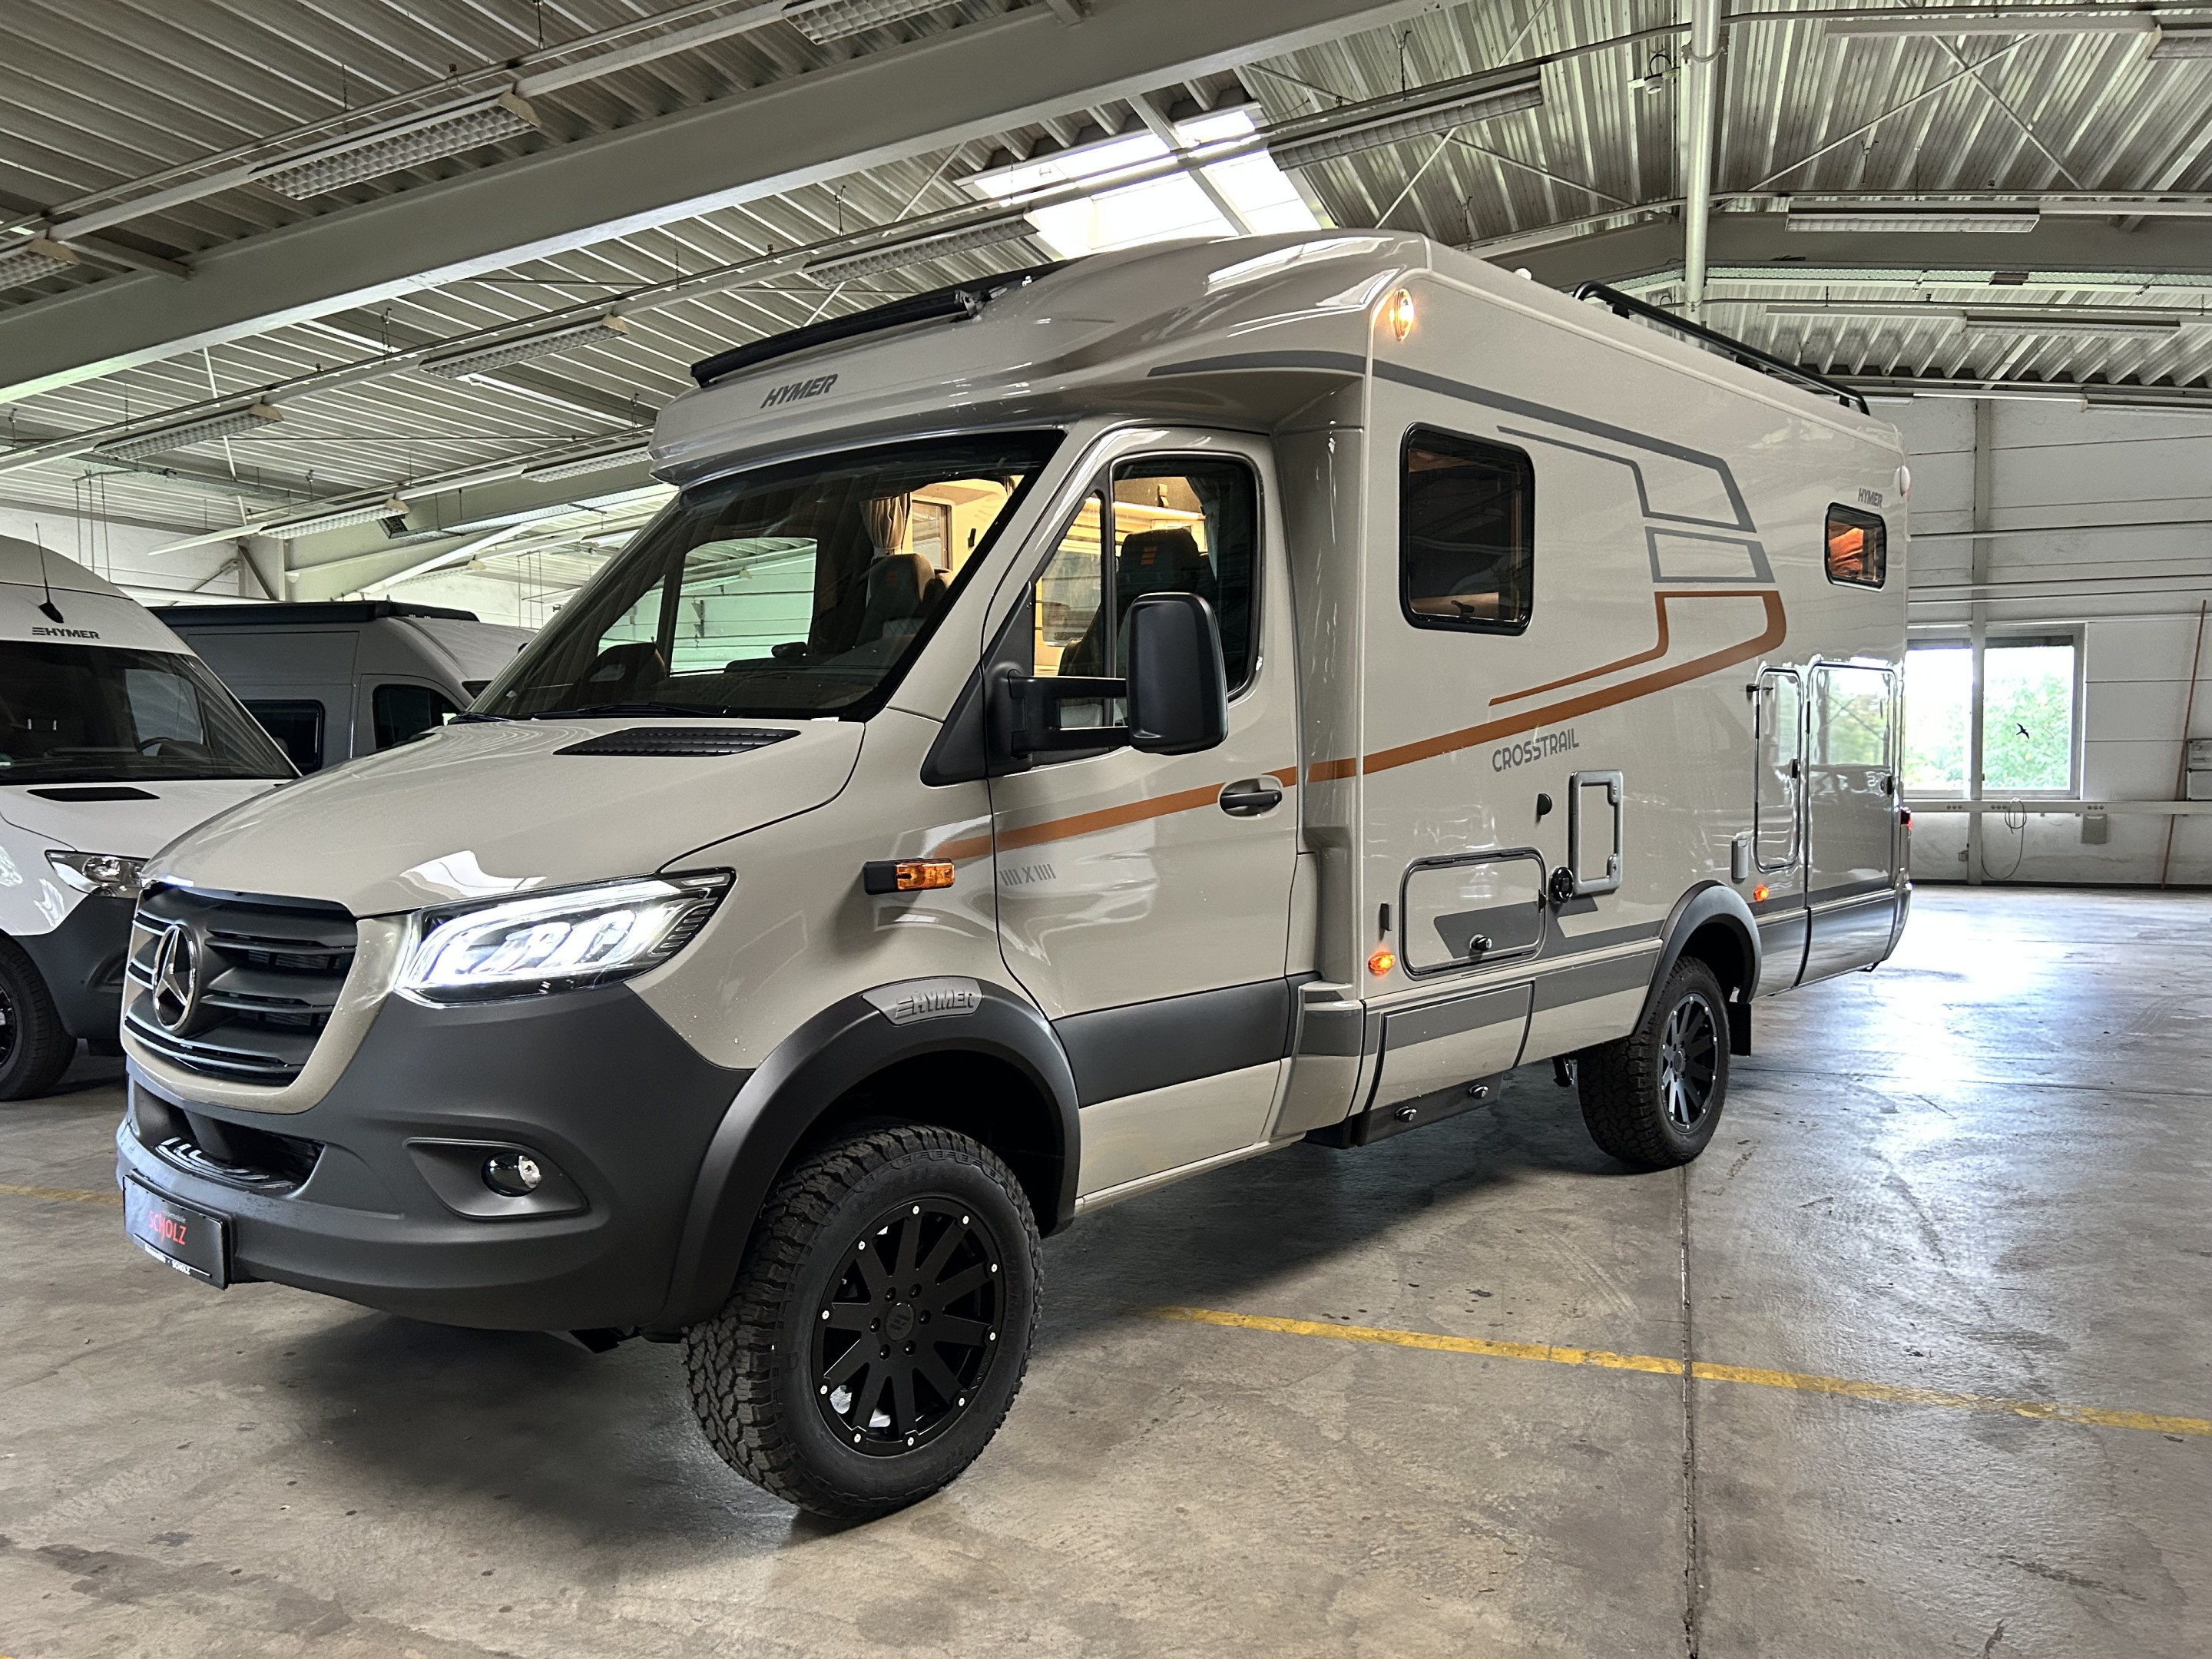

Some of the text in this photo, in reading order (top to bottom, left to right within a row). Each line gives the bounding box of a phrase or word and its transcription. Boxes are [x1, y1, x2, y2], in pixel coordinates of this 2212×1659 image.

[760, 374, 838, 409] HYMER
[1857, 488, 1883, 508] HYMER
[45, 627, 100, 639] HYMER
[1492, 728, 1579, 772] CROSSTRAIL
